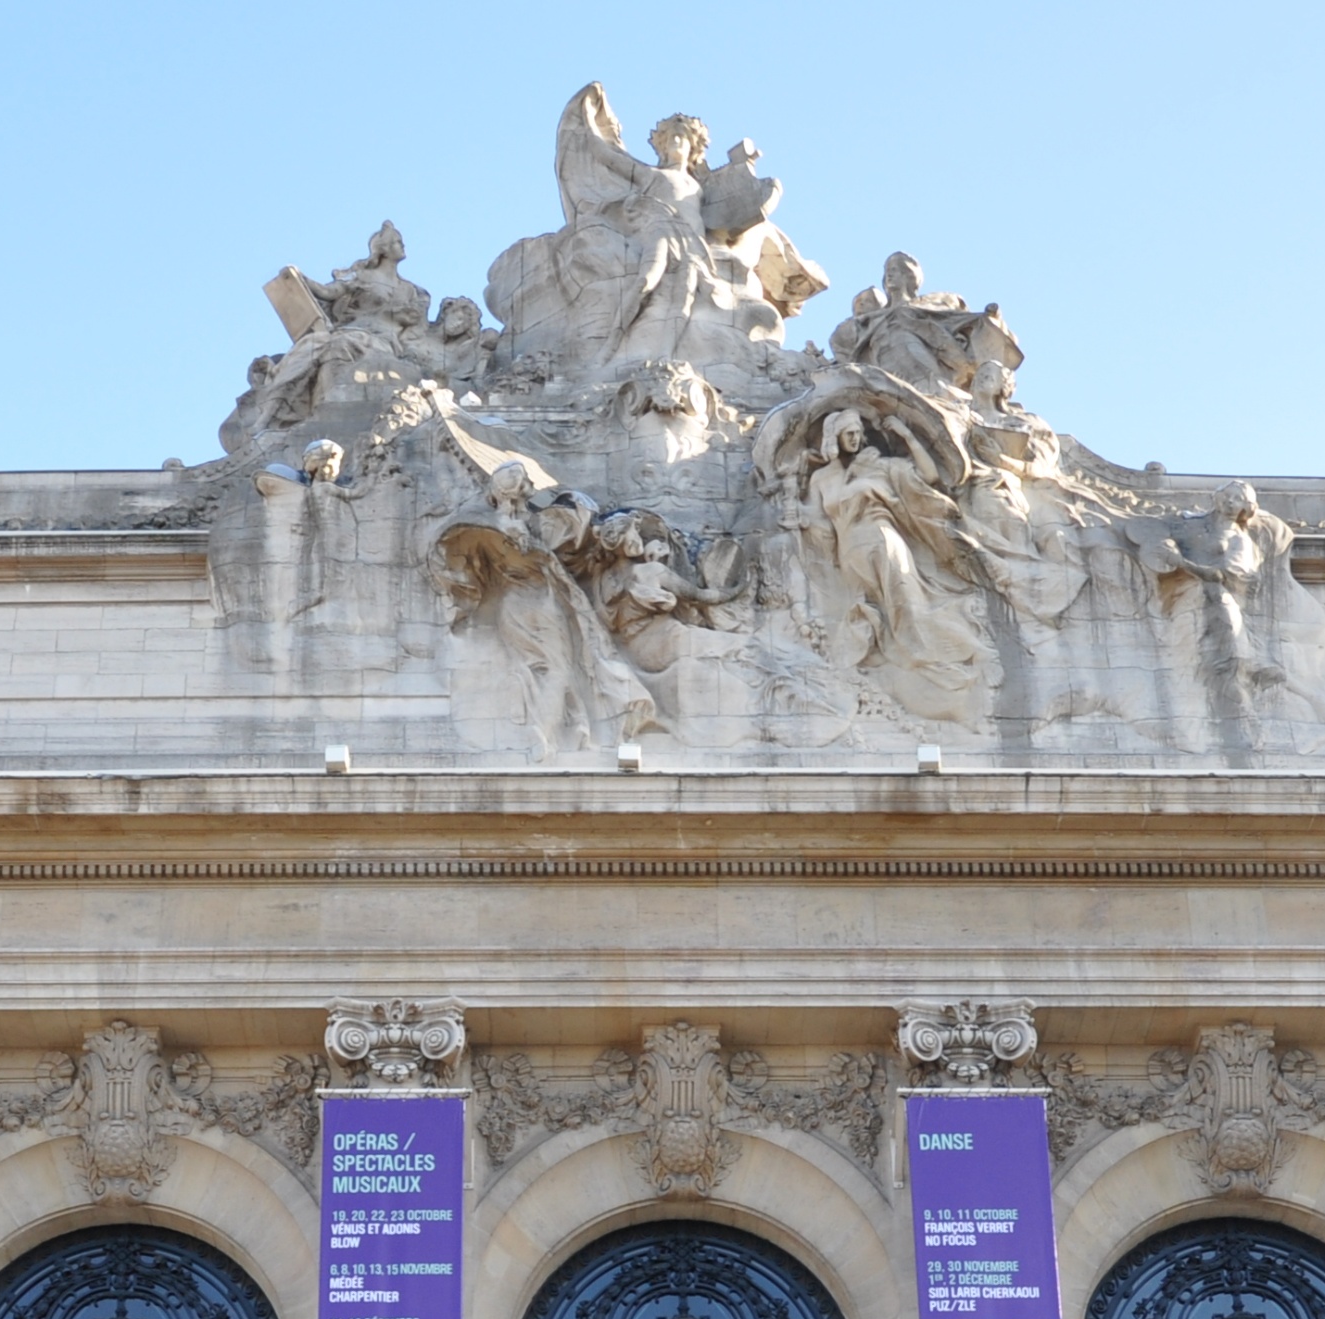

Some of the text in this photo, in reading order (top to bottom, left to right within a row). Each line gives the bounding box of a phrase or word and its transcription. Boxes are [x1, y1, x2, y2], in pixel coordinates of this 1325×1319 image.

[333, 1130, 398, 1151] OPÉRAS
[919, 1133, 973, 1150] DANSE
[333, 1154, 436, 1172] SPECTACLES
[333, 1176, 421, 1193] MUSICAUX
[331, 1222, 420, 1234] VÉNUS ET ADONIS
[925, 1222, 1014, 1233] FRANÇOIS VERRET
[331, 1237, 360, 1248] BLOW
[925, 1233, 977, 1246] NO FOCUS
[929, 1287, 1040, 1298] SIDI LARBI CHERKAOUI
[929, 1300, 976, 1311] PUZ/ZLE
